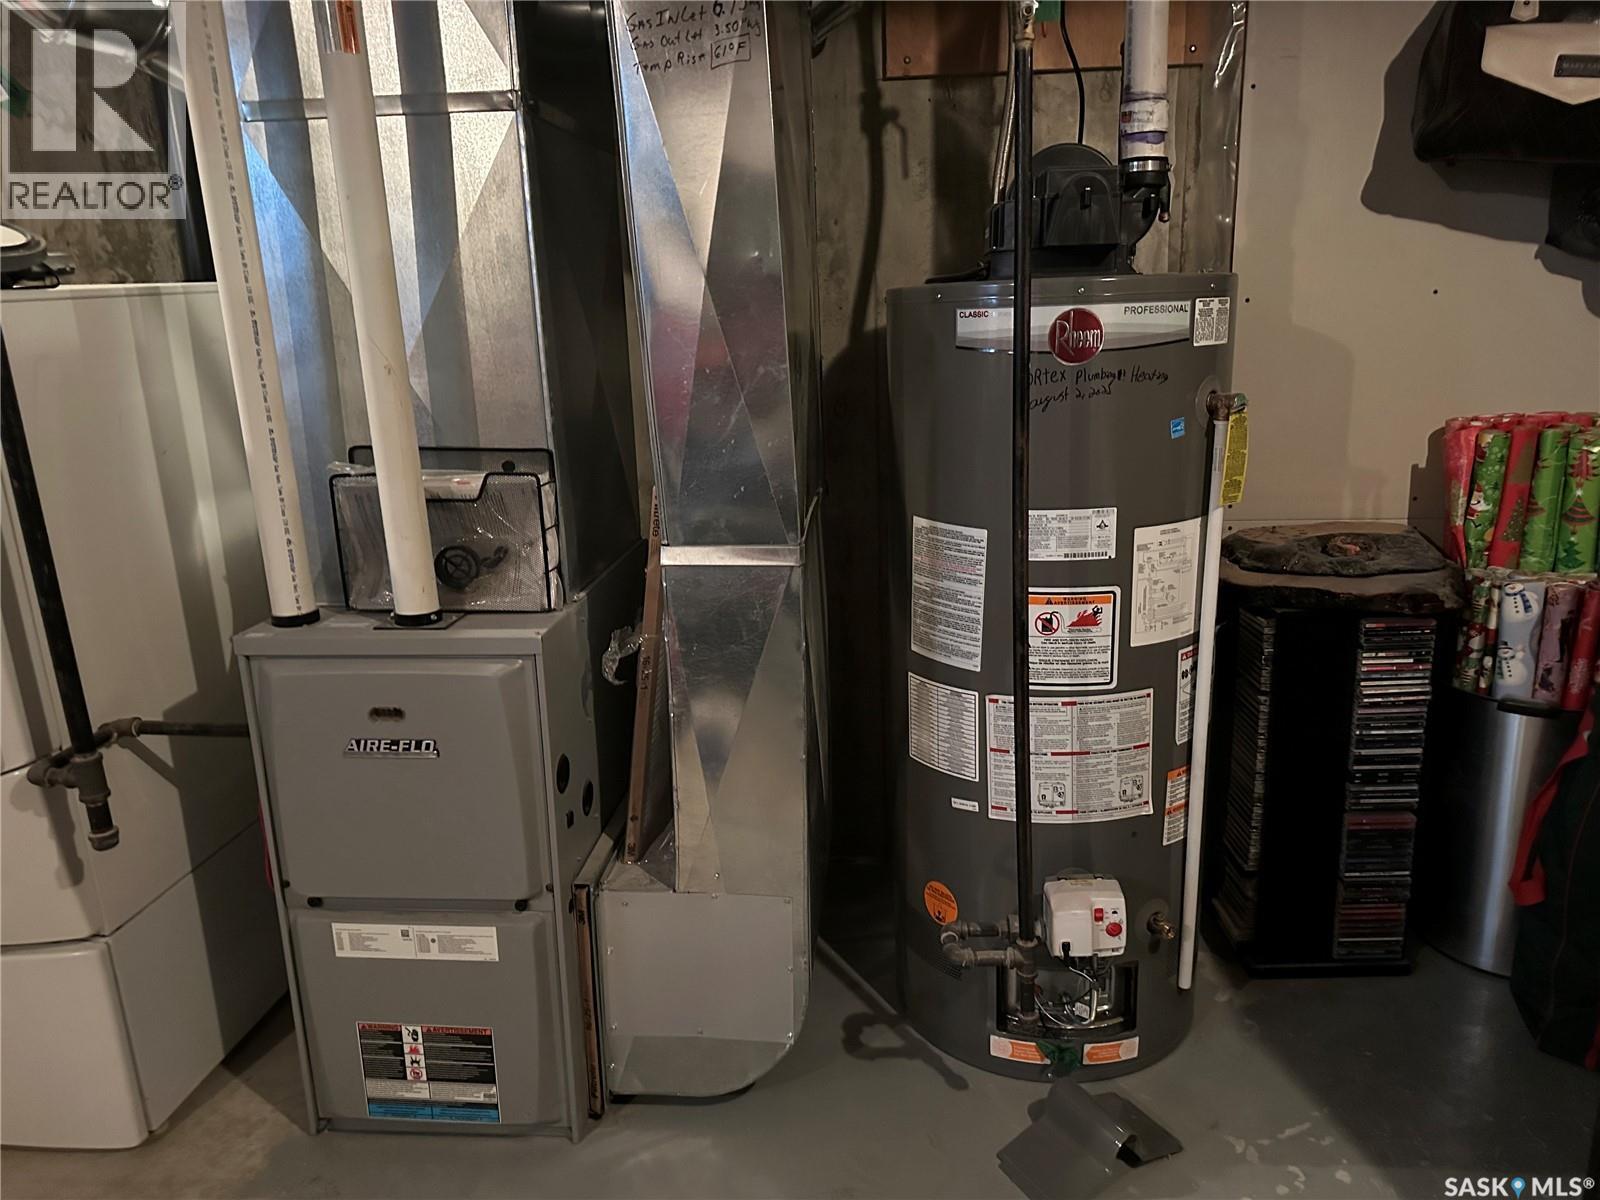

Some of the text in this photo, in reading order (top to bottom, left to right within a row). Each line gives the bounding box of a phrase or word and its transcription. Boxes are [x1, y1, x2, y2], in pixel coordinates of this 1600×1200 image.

[959, 310, 989, 319] CLASSIC
[1124, 304, 1189, 316] PROFESSIONAL
[1055, 310, 1101, 355] Rheem
[346, 739, 436, 753] AIRE-FLO
